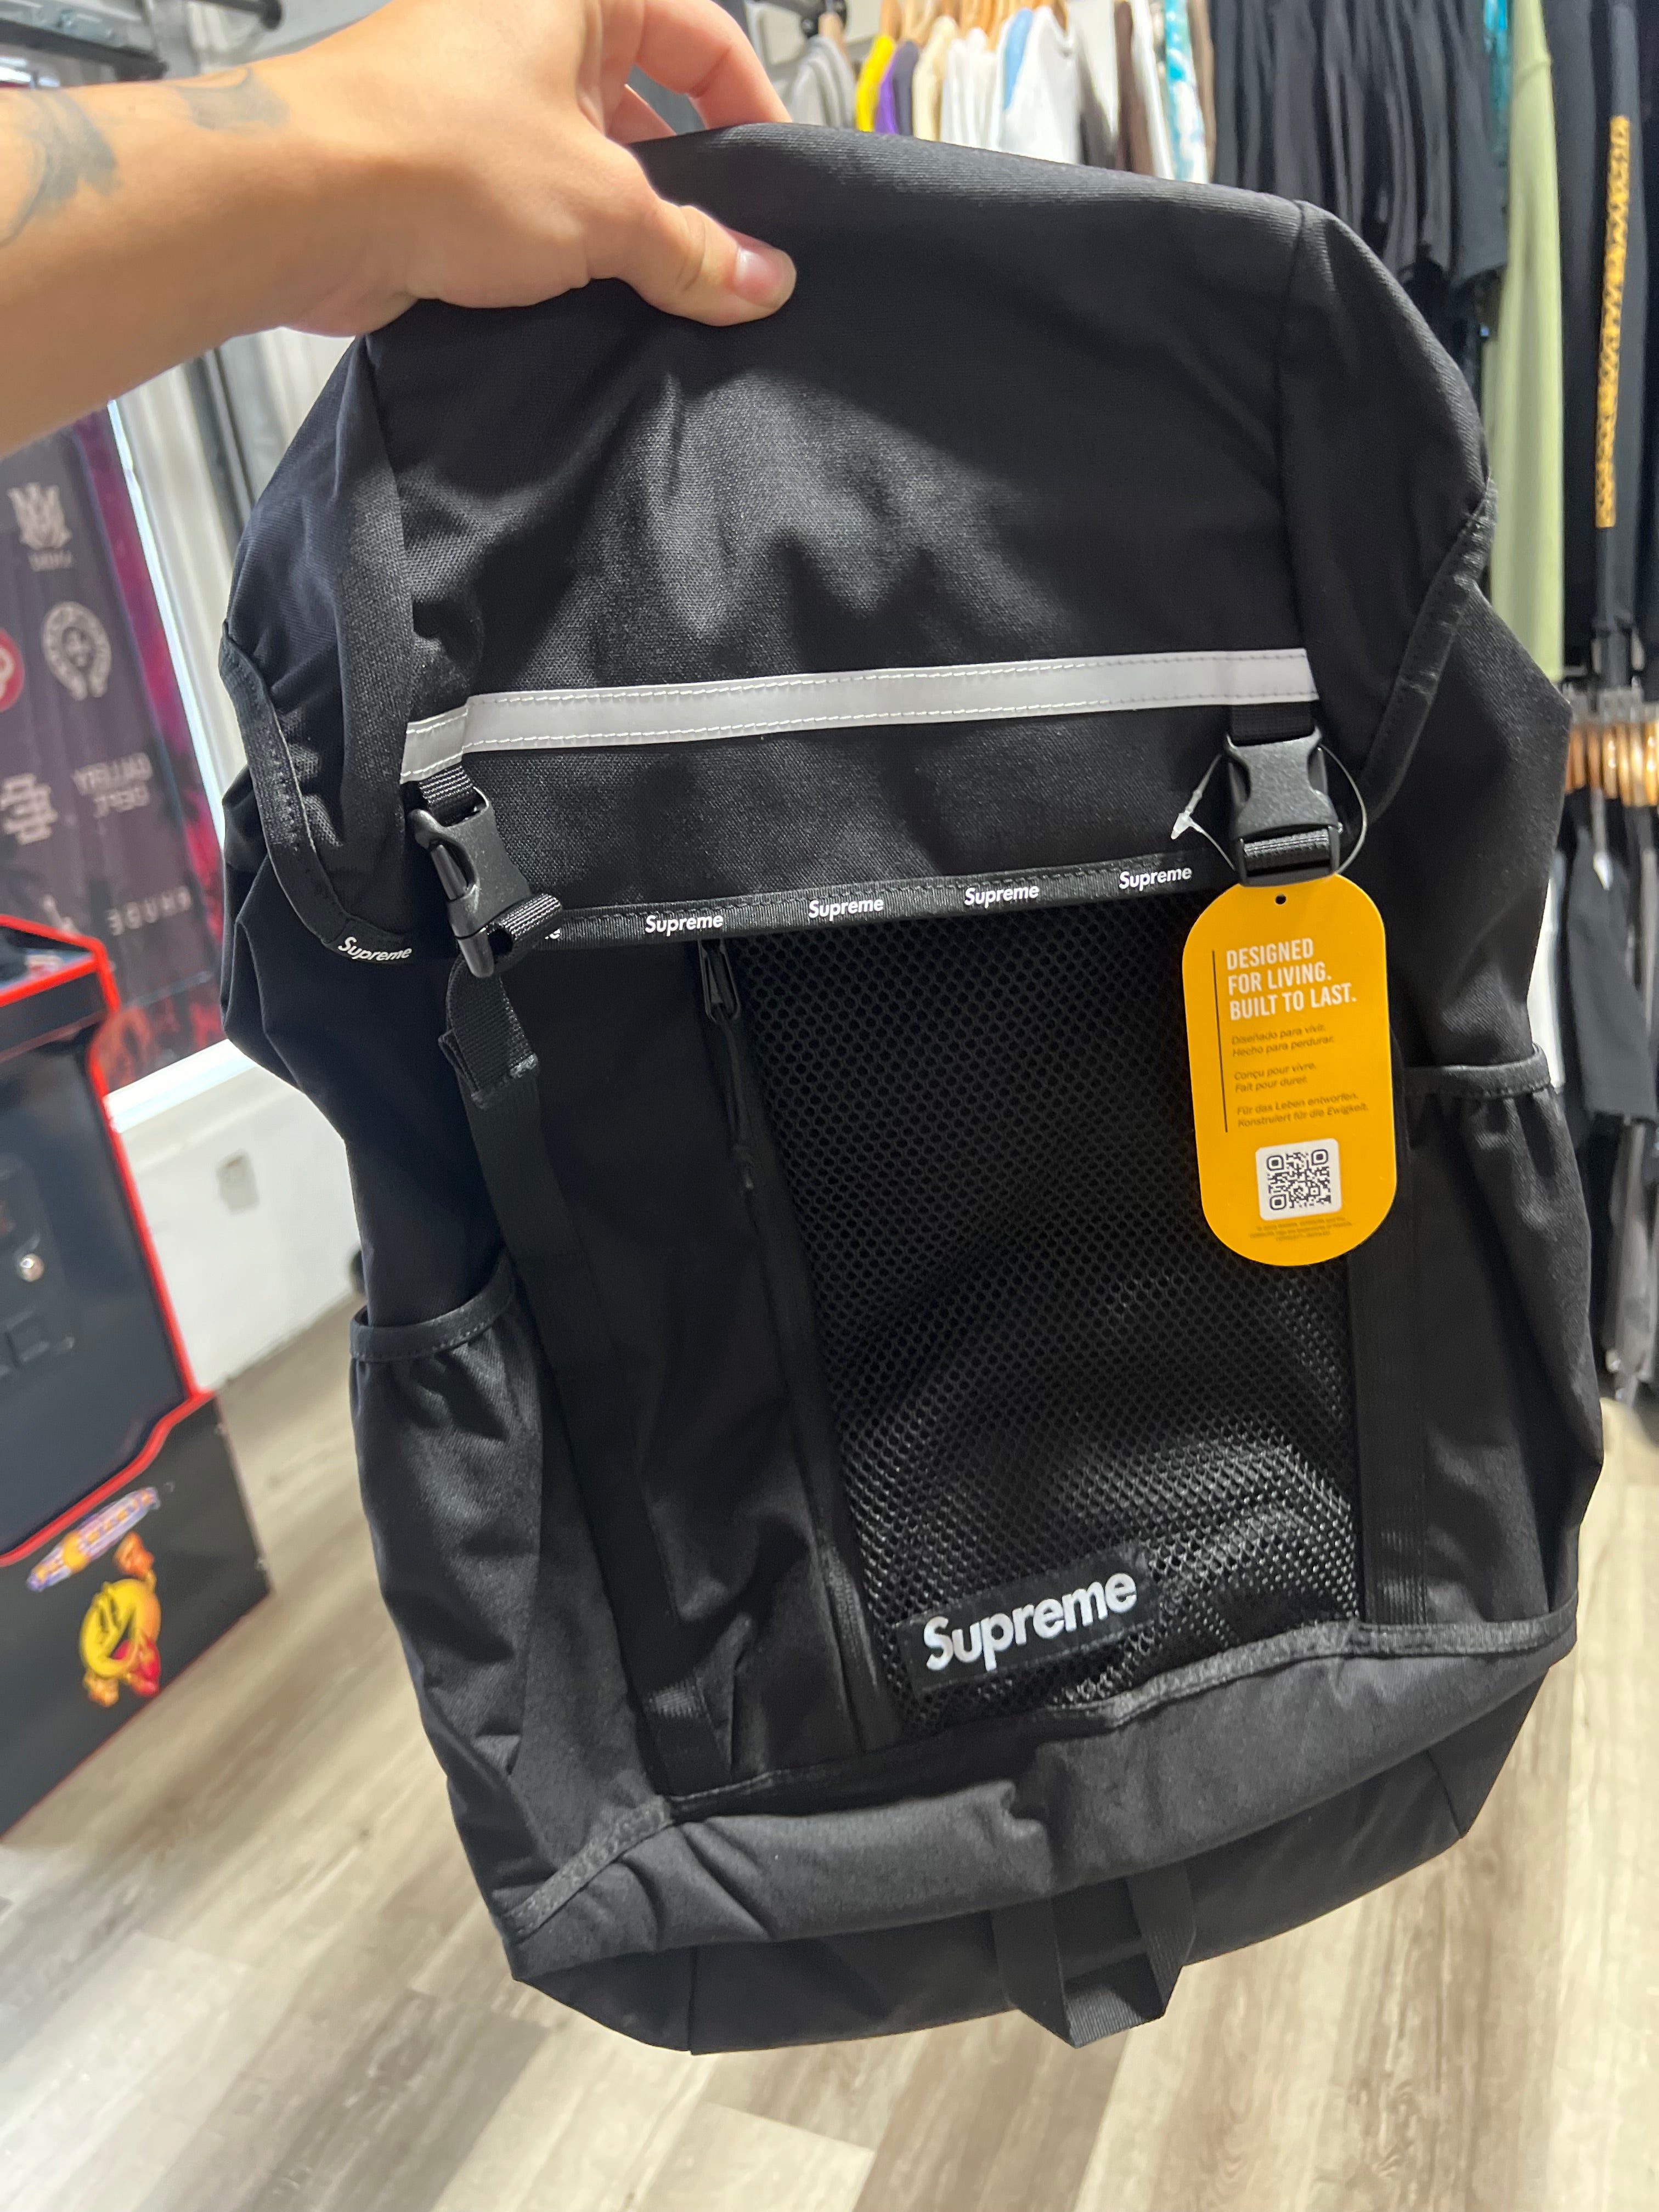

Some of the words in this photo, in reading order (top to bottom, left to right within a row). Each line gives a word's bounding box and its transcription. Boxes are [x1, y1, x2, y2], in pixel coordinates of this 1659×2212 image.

[1118, 864, 1193, 890] Supreme
[964, 883, 1040, 907] Supreme
[808, 896, 884, 919] Supreme
[645, 915, 723, 936] Supreme
[338, 936, 412, 961] Supreme
[1227, 938, 1314, 970] DESIGNED
[1228, 972, 1262, 996] FOR
[1267, 961, 1331, 990] LIVING.
[1230, 995, 1278, 1020] BUILT
[1282, 990, 1304, 1013] TO
[1310, 982, 1357, 1008] LAST.
[1232, 1031, 1277, 1045] Diseñado
[1280, 1029, 1302, 1038] para
[1233, 1045, 1263, 1057] Hecho
[1266, 1043, 1288, 1053] para
[1291, 1036, 1334, 1049] perdurar.
[1234, 1070, 1264, 1080] Conçu
[1267, 1066, 1289, 1077] pour
[1235, 1082, 1253, 1093] Fait
[1255, 1081, 1277, 1091] pour
[1237, 1106, 1252, 1115] Für
[1255, 1105, 1272, 1113] das
[1276, 1099, 1305, 1110] Leben
[1238, 1114, 1291, 1127] Konstruiert
[1294, 1111, 1307, 1120] für
[1310, 1109, 1324, 1119] die
[923, 1572, 1137, 1672] Supreme
